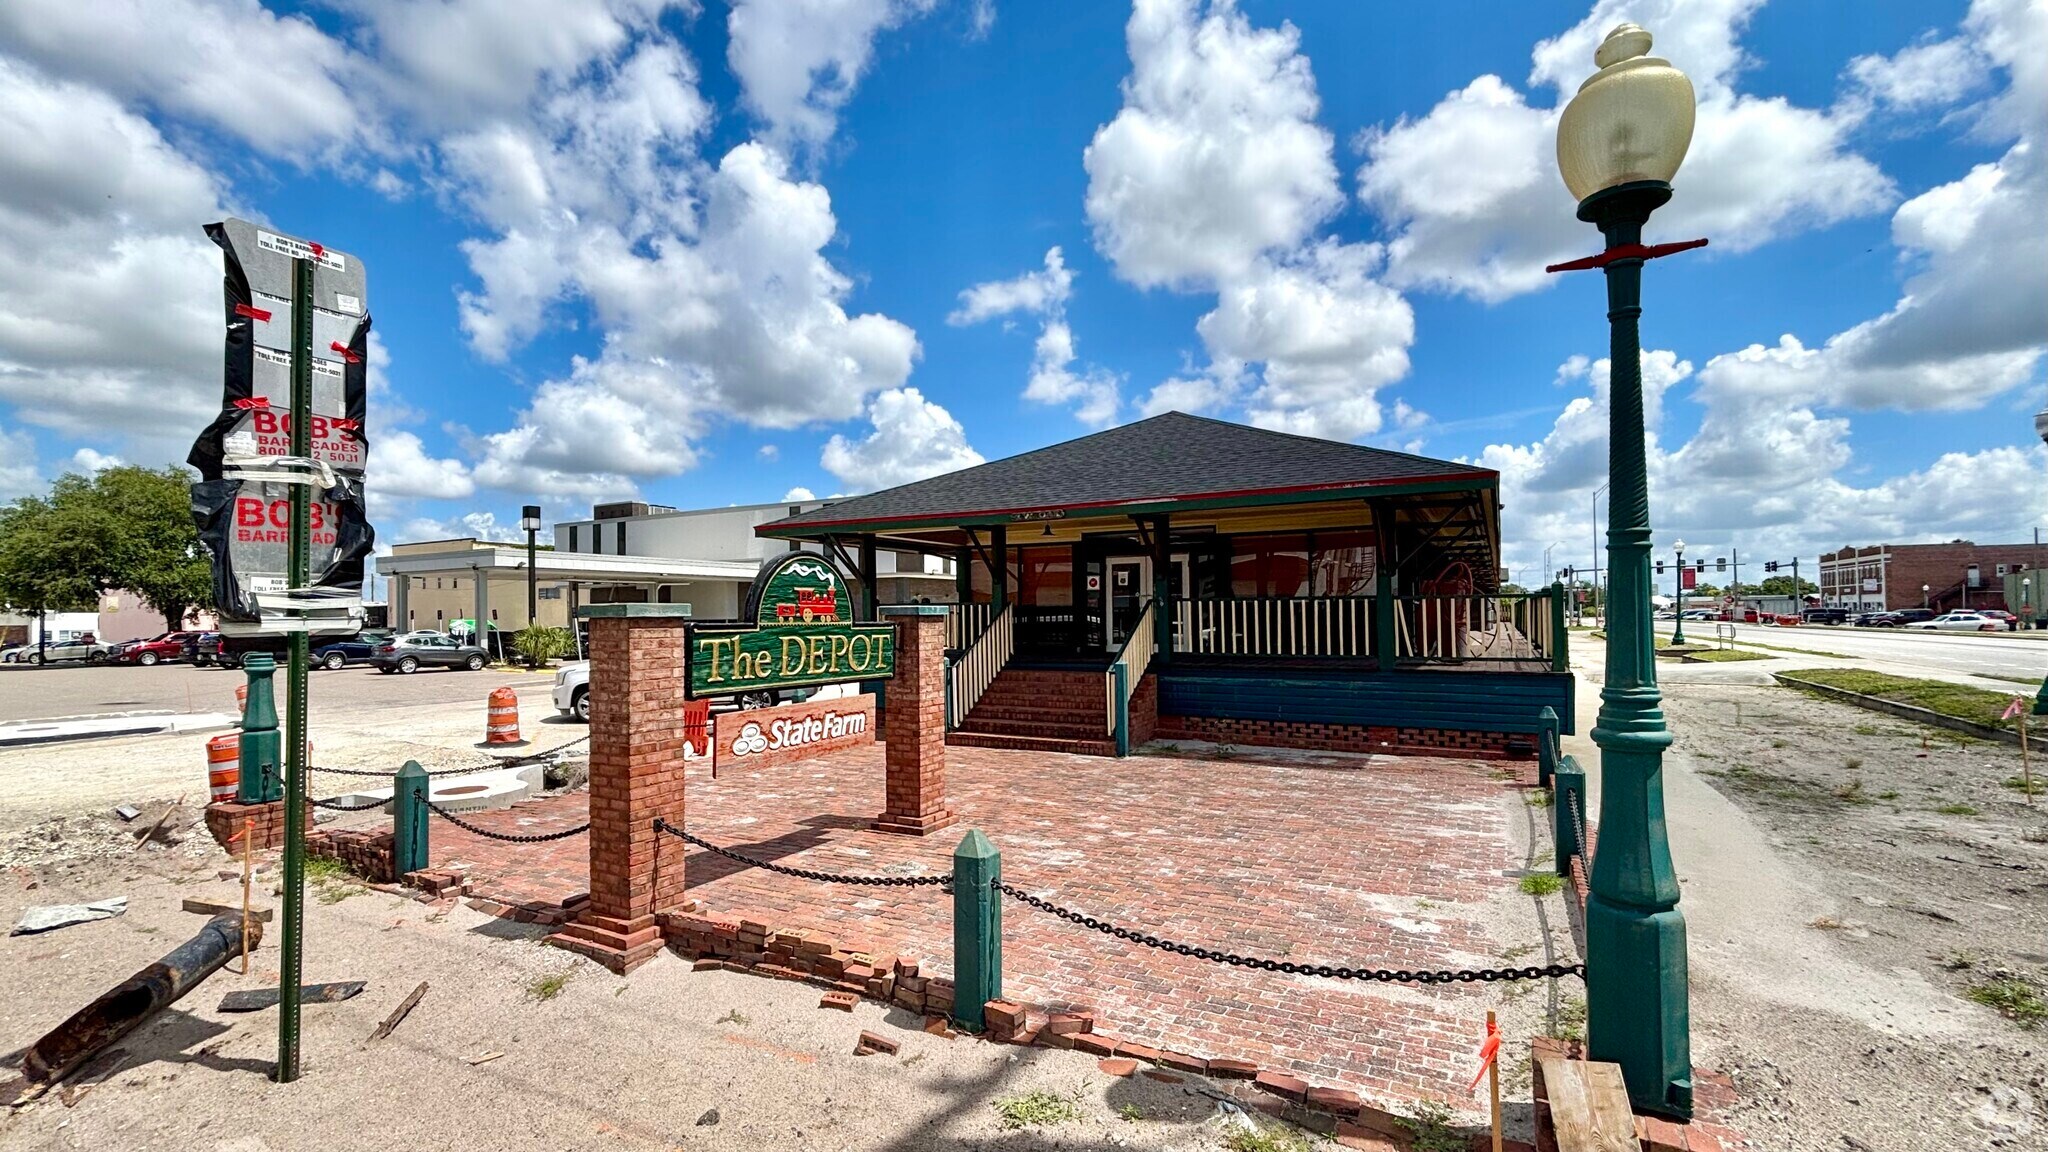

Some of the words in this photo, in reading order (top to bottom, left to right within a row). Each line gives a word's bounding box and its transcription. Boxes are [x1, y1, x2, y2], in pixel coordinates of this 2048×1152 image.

[260, 241, 273, 249] TOLL
[276, 245, 289, 253] FREE
[258, 352, 272, 360] TOLL
[258, 435, 358, 453] BARCADES
[258, 446, 287, 456] 800
[700, 635, 772, 683] The
[779, 634, 891, 677] DEPOT
